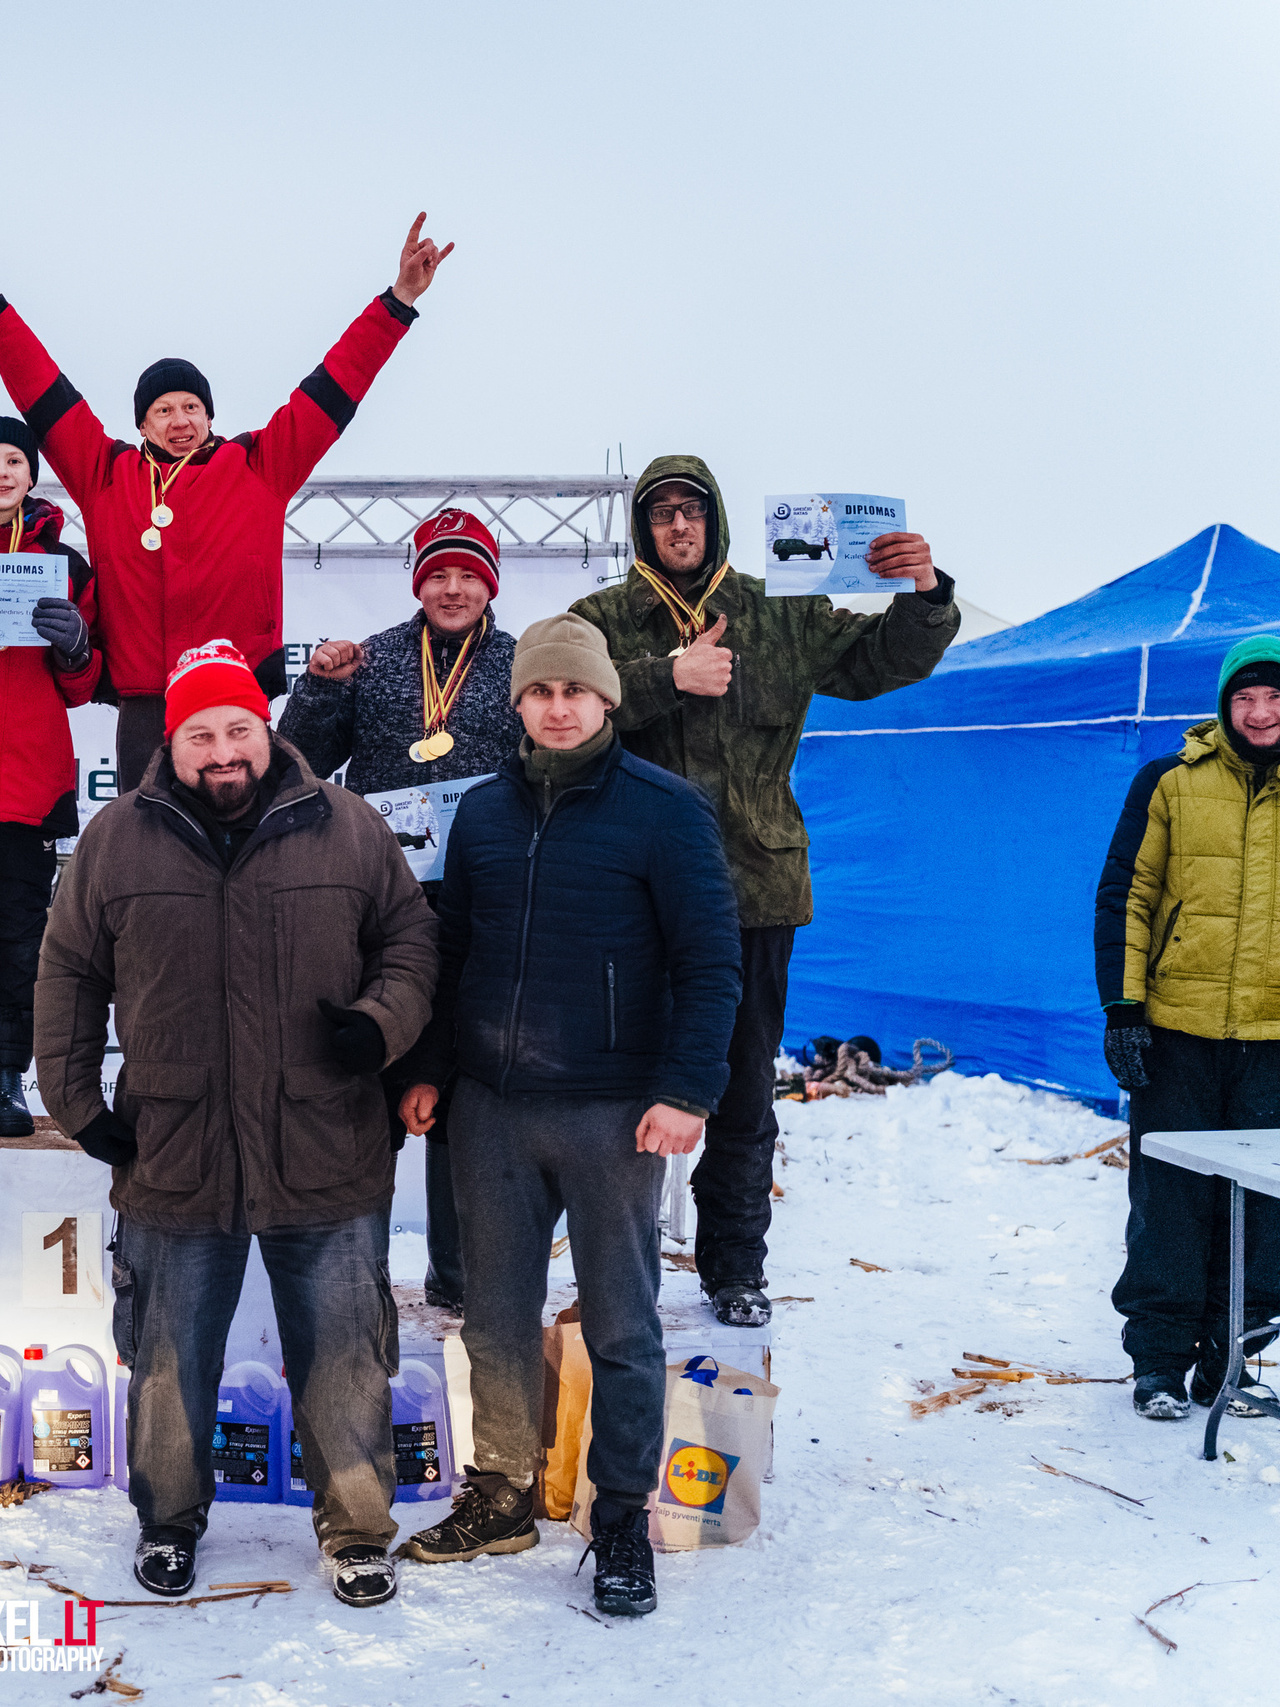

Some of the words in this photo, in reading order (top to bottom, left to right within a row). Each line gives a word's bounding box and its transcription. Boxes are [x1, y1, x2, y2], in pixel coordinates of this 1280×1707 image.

[845, 504, 896, 518] DIPLOMAS
[43, 1217, 78, 1294] 1
[655, 1506, 670, 1517] Taip
[671, 1511, 701, 1523] gyventi
[701, 1517, 722, 1527] verta
